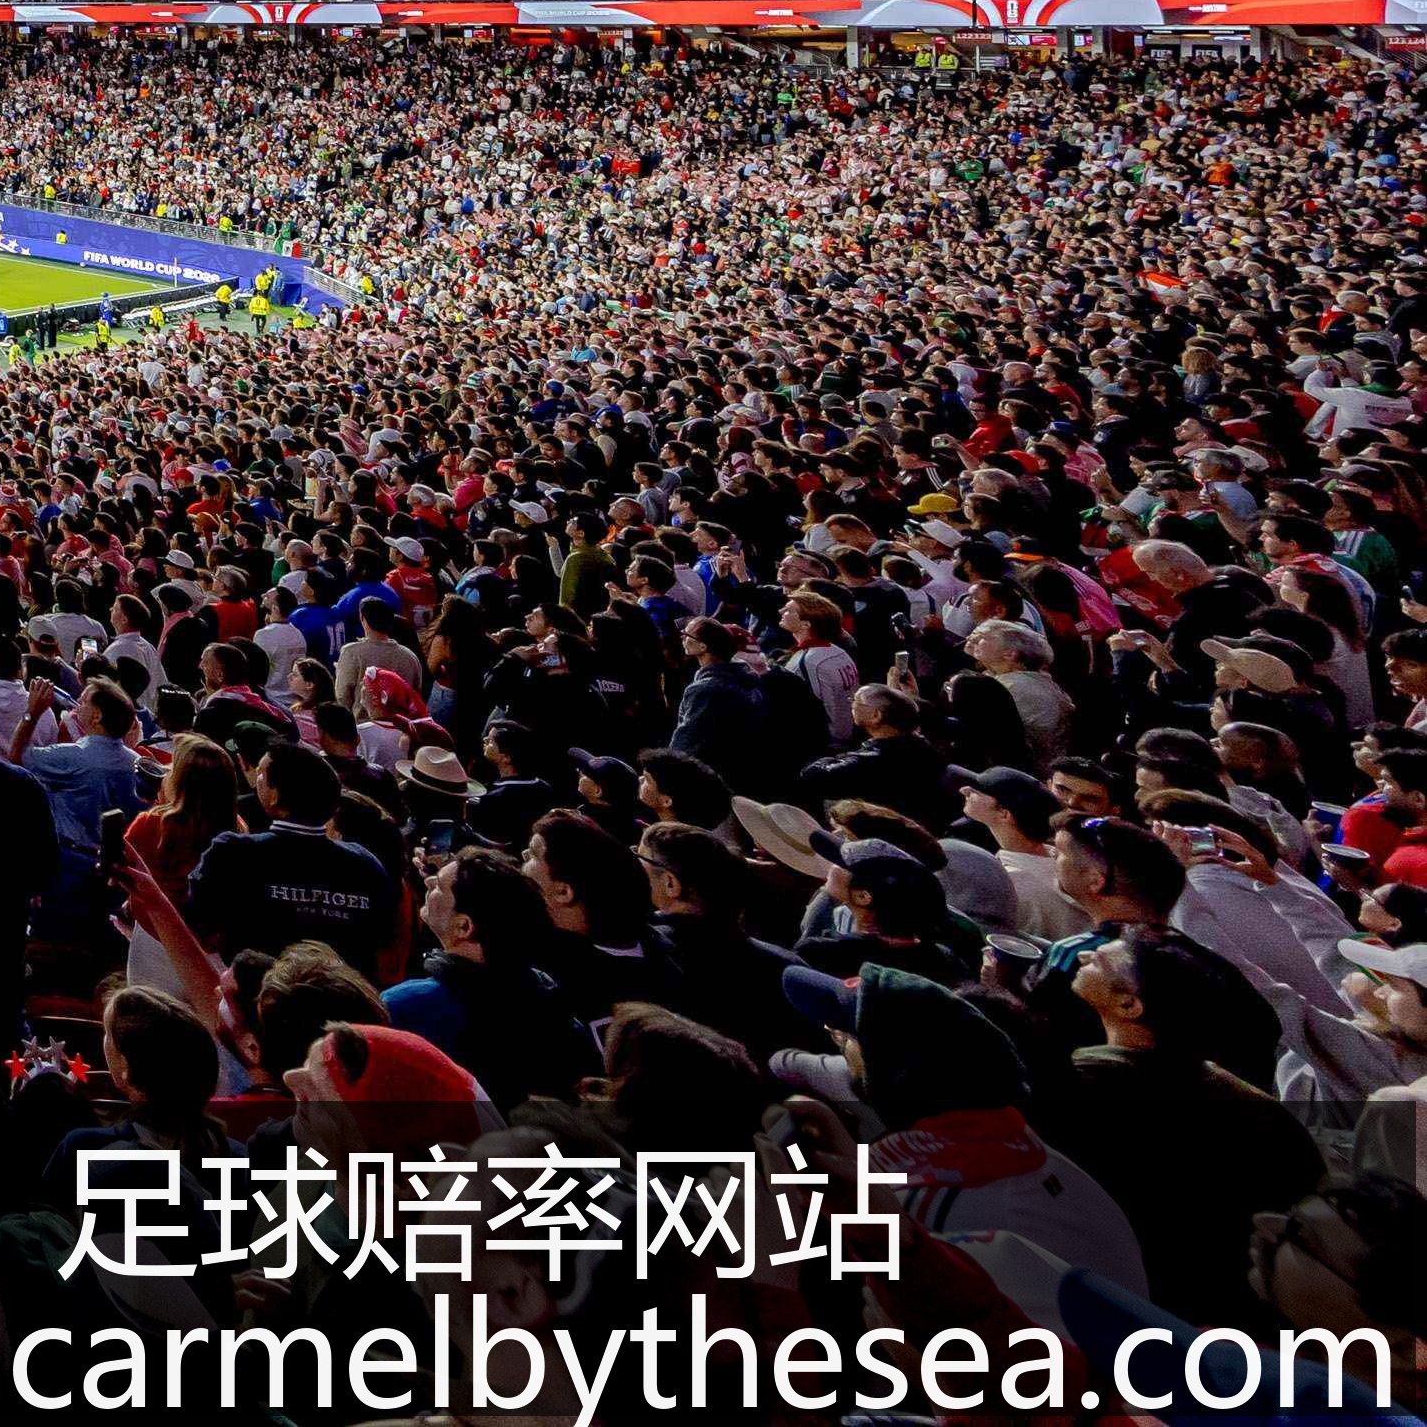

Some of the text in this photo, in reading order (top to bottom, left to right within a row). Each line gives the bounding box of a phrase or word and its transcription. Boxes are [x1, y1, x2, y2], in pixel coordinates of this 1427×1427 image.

[83, 250, 109, 265] FIFA
[110, 255, 155, 272] WORLD
[156, 263, 183, 275] CUP
[270, 885, 370, 909] HILFIGER
